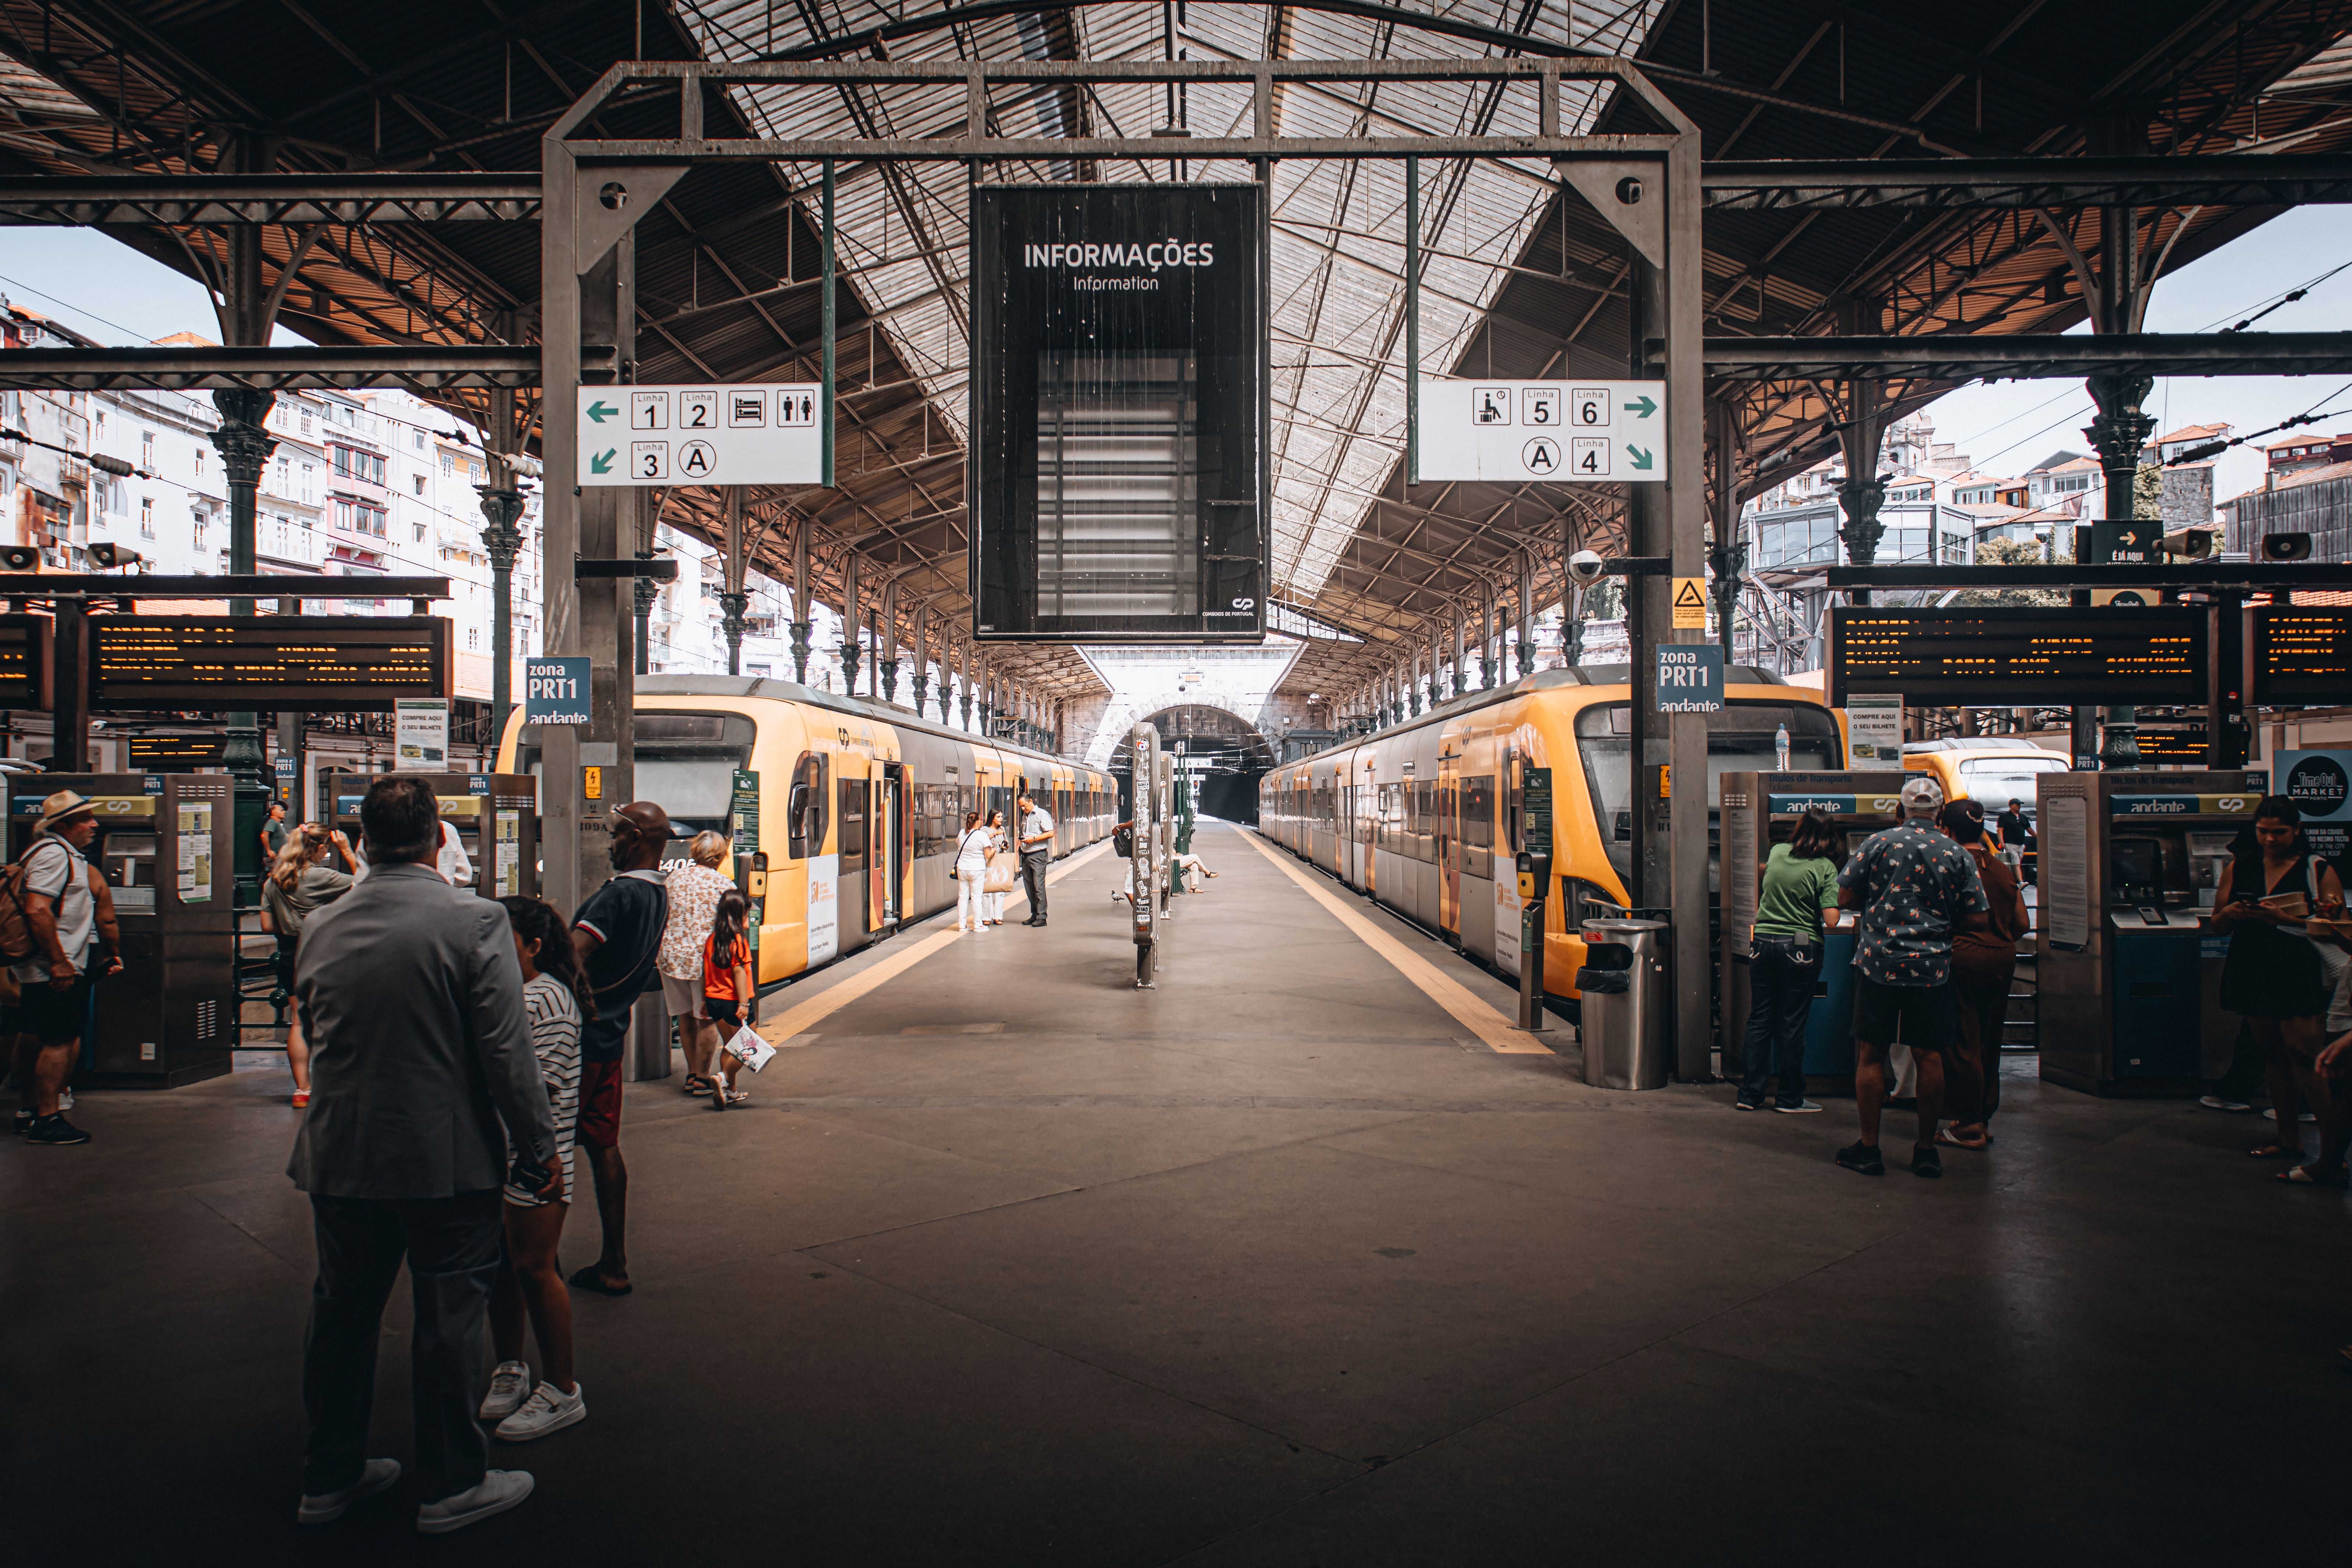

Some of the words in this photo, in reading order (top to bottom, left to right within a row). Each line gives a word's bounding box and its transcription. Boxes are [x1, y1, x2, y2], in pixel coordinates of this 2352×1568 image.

[1025, 238, 1213, 272] INFORMAÇÕES
[1075, 276, 1158, 291] Information
[686, 393, 712, 402] Linha
[644, 405, 655, 427] 1
[691, 405, 706, 427] 2
[1534, 401, 1549, 424] 5
[1582, 402, 1597, 424] 6
[638, 443, 663, 451] Linha
[644, 455, 658, 477] 3
[686, 449, 708, 471] A
[1530, 445, 1552, 467] A
[1582, 450, 1598, 473] 4
[2112, 550, 2117, 560] É
[2118, 550, 2126, 560] JÁ
[2127, 552, 2144, 562] AQUI
[1233, 598, 1254, 610] CP
[1660, 652, 1696, 663] zona
[529, 665, 566, 676] zona
[1660, 666, 1708, 687] PRT1
[529, 678, 577, 699] PRT1
[1661, 698, 1720, 712] andante
[530, 710, 588, 724] andante
[1769, 774, 1795, 782] Títulos
[1796, 773, 1807, 782] de
[1809, 774, 1852, 784] Transporte
[1769, 783, 1793, 791] Tickets
[1787, 799, 1840, 811] andante
[2131, 799, 2185, 812] andante
